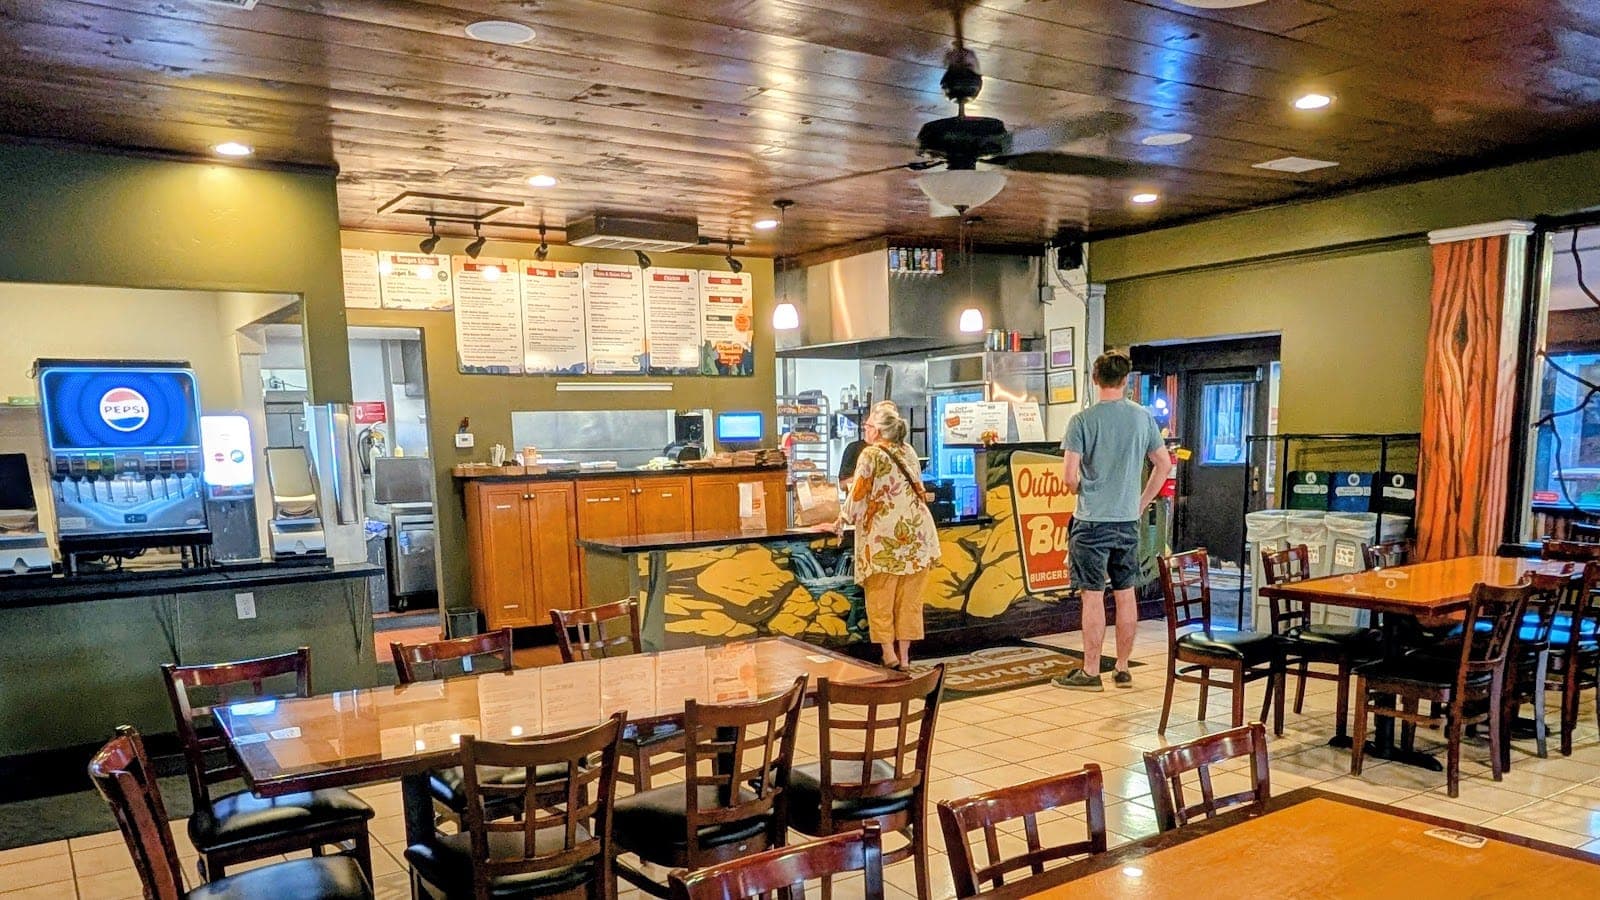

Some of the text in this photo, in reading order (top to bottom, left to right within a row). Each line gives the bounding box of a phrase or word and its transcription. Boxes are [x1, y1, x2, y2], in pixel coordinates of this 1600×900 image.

[104, 405, 145, 414] PEPSI
[1017, 467, 1078, 508] Outpo
[1030, 569, 1068, 583] BURGERS
